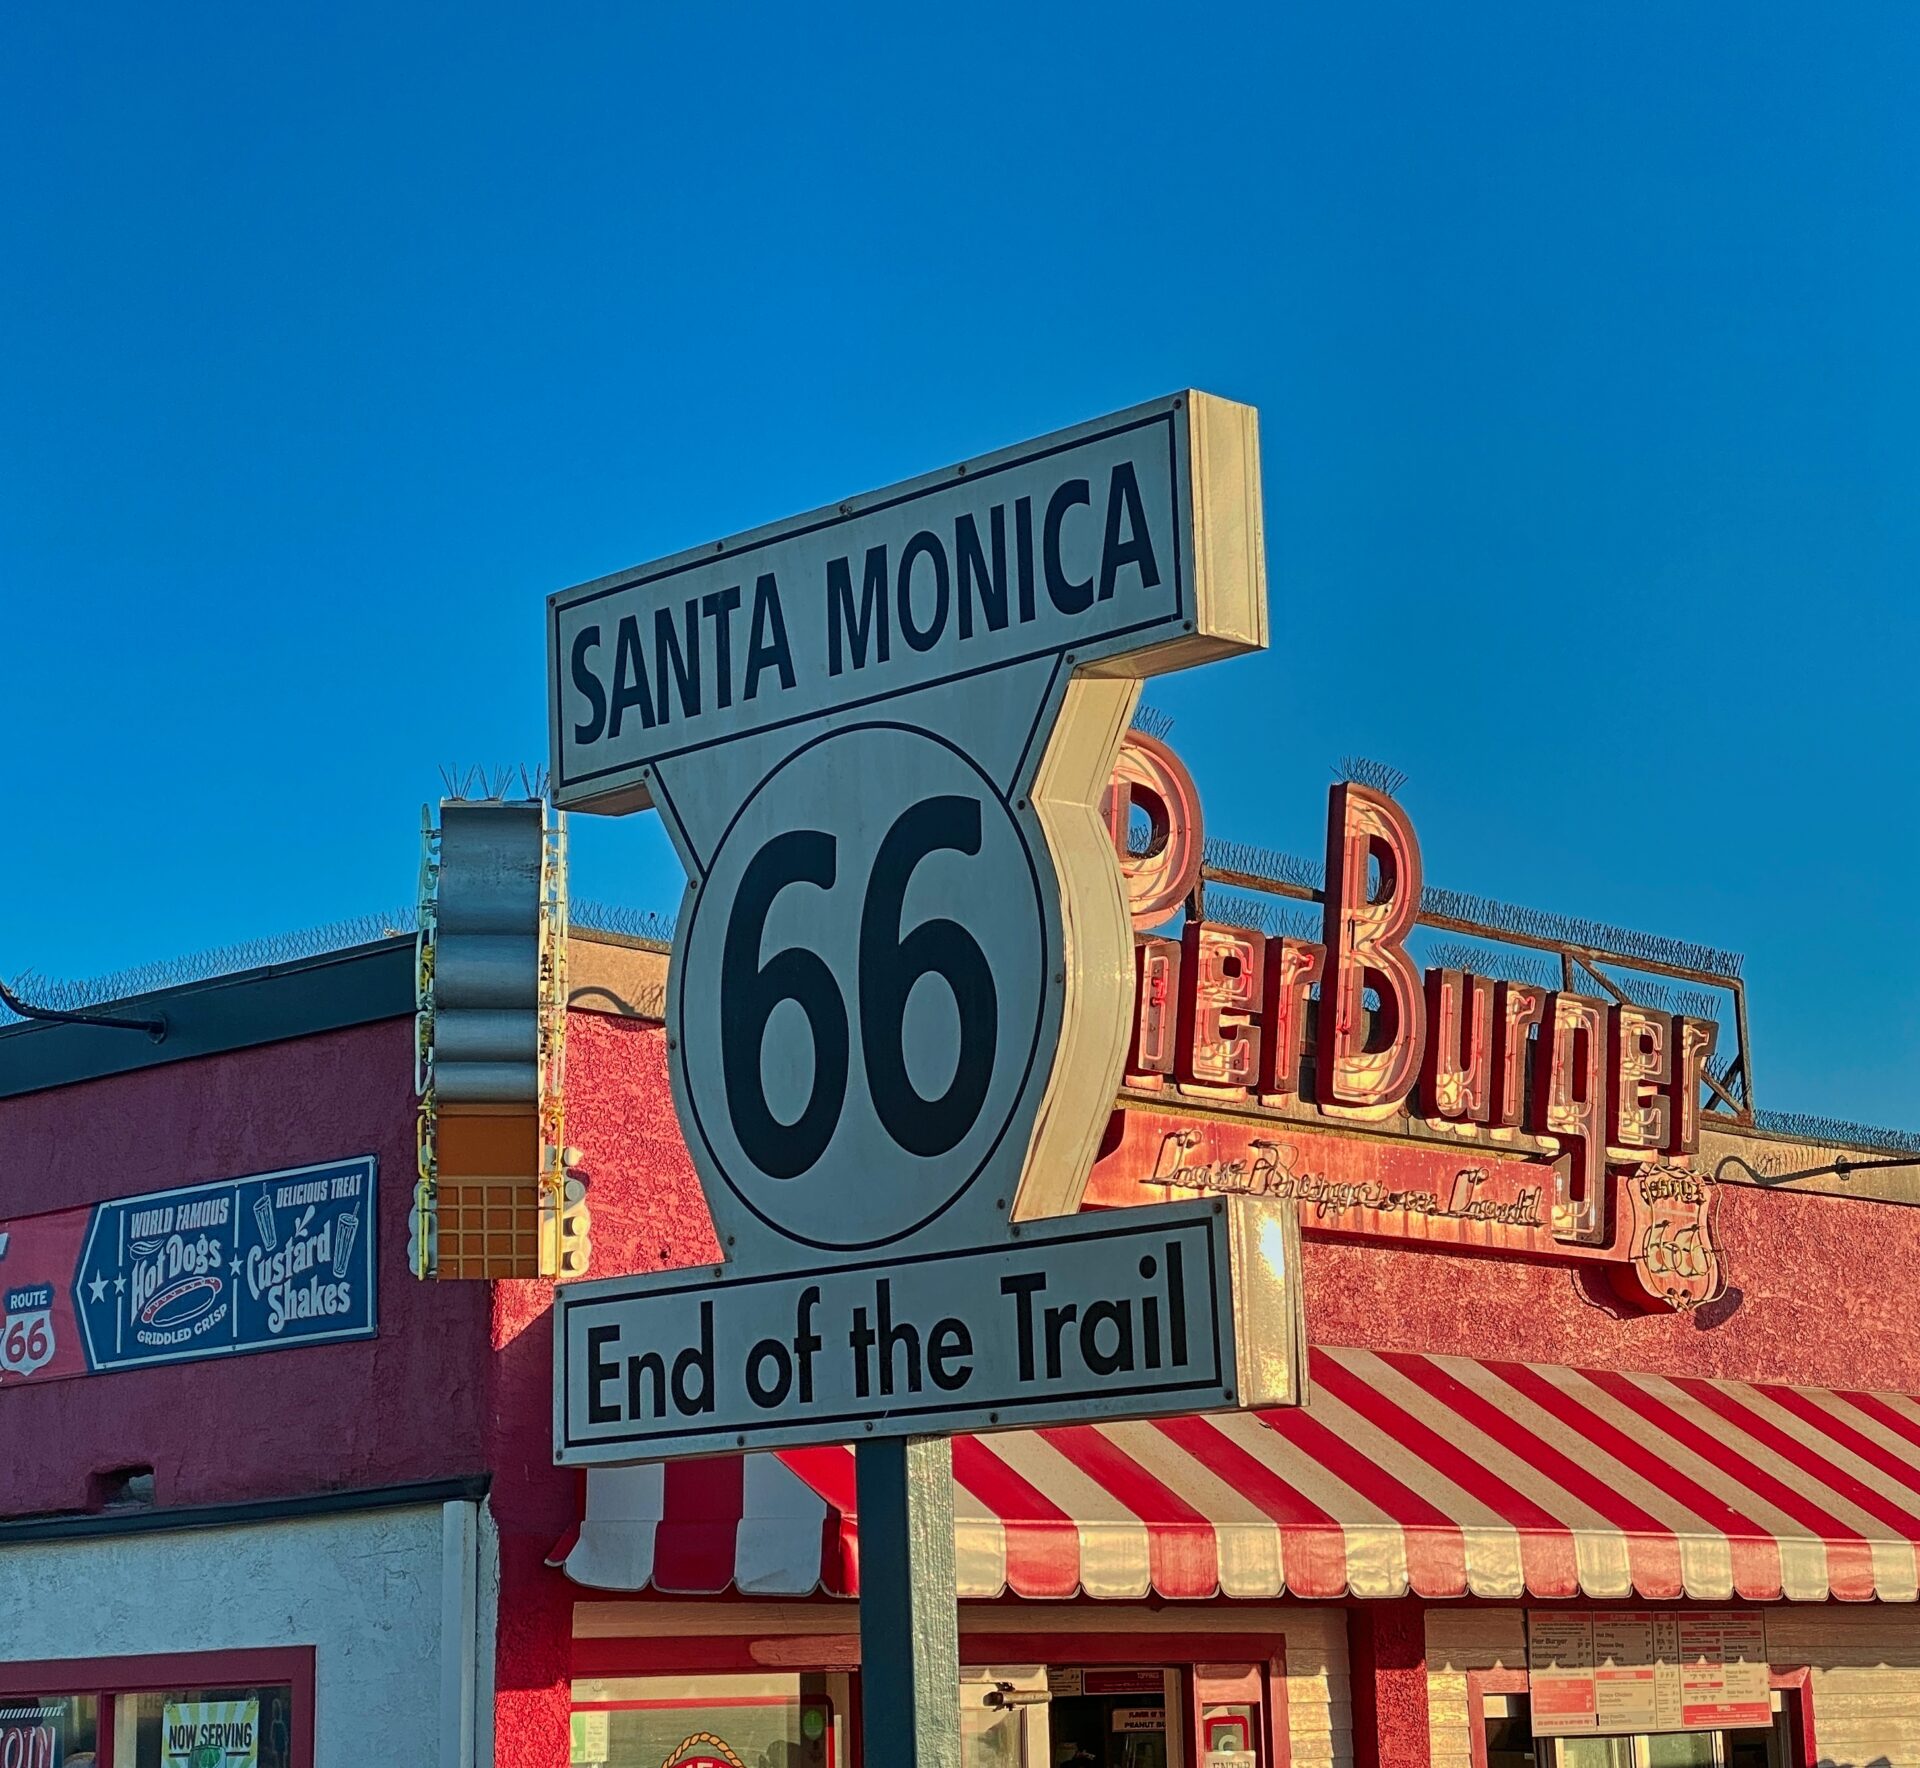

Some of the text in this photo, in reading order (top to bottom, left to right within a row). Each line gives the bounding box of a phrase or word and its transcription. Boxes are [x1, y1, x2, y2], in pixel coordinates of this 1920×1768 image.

[571, 461, 1161, 746] SANTA MONICA
[721, 795, 998, 1180] 66
[1102, 728, 1719, 1242] Pier Burger
[131, 1198, 230, 1238] WORLD FAMOUS
[276, 1174, 363, 1208] DELICIOUS TREAT
[130, 1234, 221, 1327] Hot Dogs
[247, 1220, 332, 1300] Custard
[10, 1290, 48, 1309] ROUTE
[137, 1303, 227, 1346] GRIDDLED CRISP
[267, 1275, 351, 1333] Shakes
[6, 1318, 48, 1363] 66
[587, 1241, 1188, 1424] End of the Trail
[169, 1722, 253, 1750] NOW SERVING
